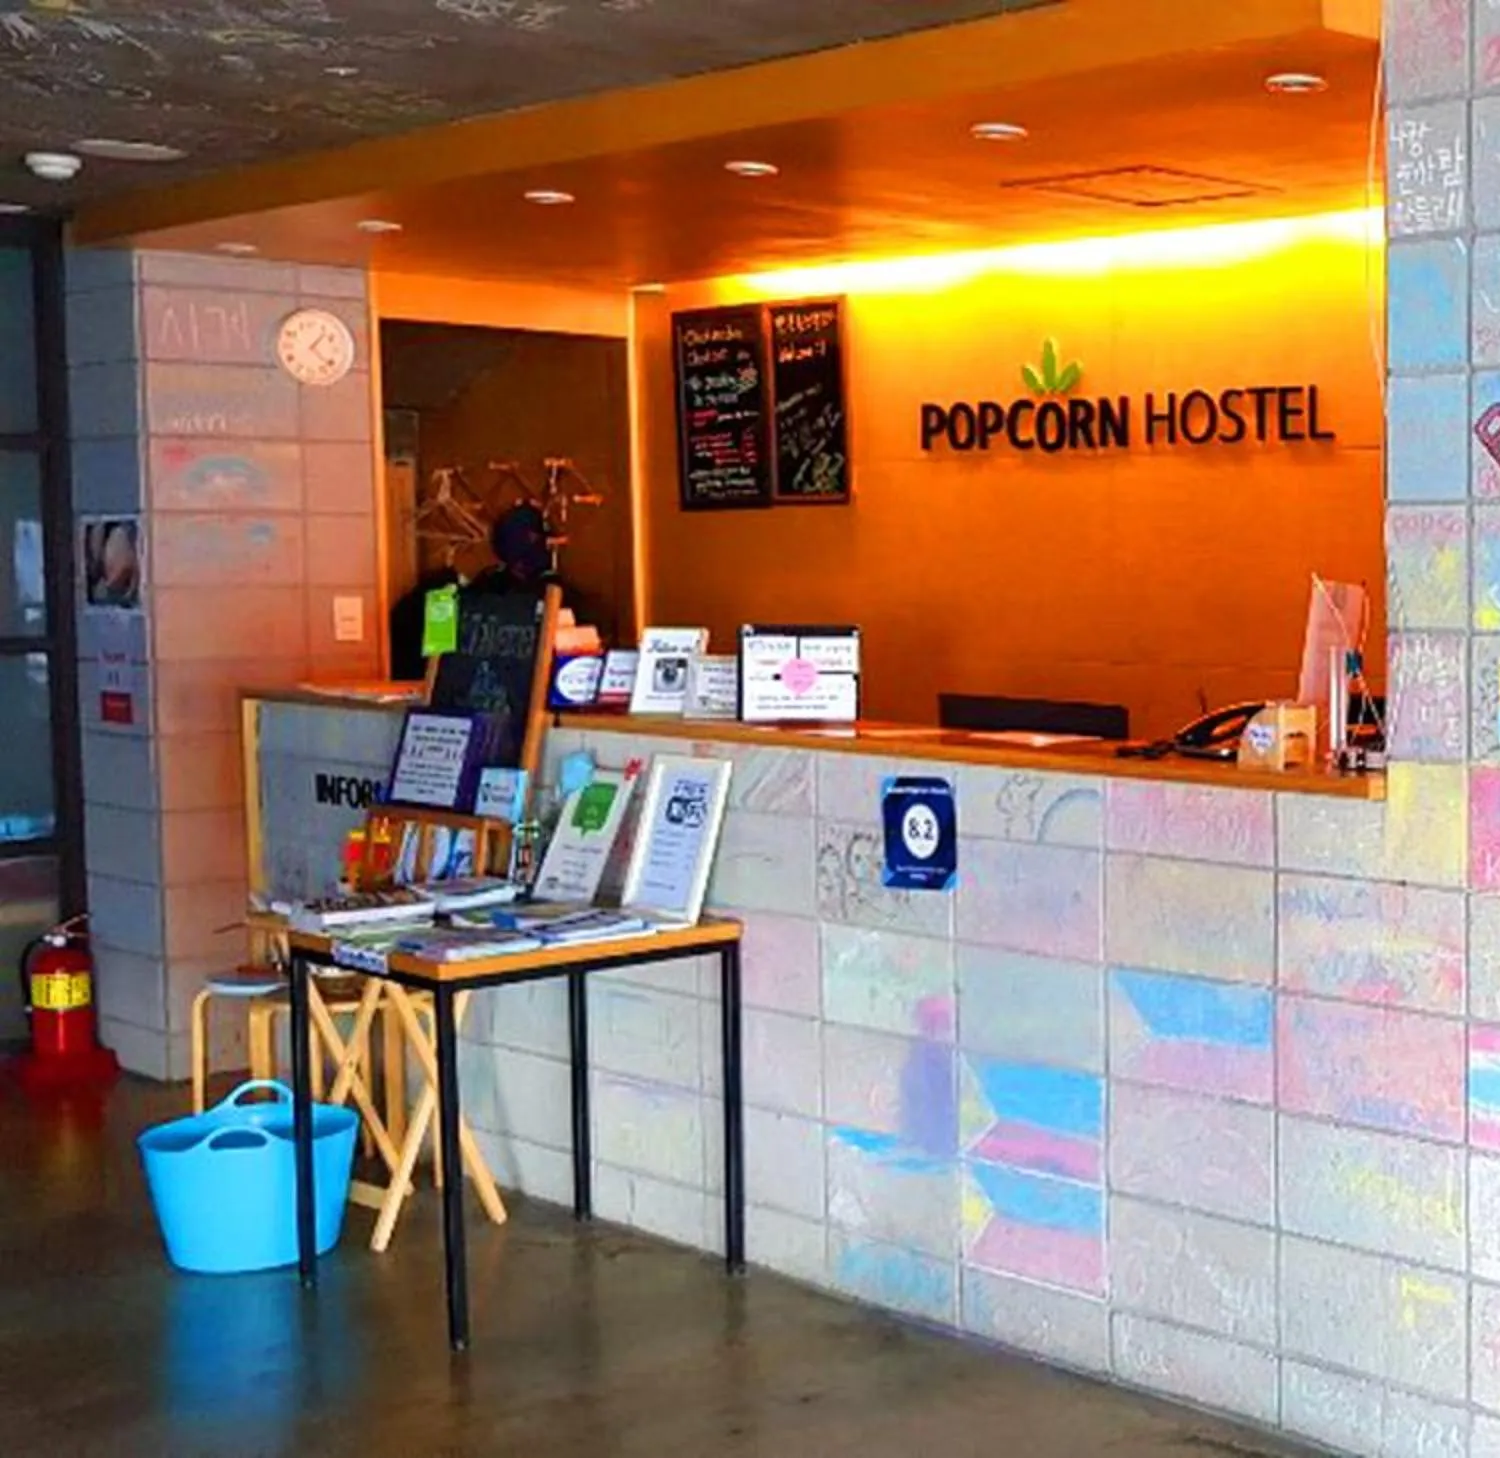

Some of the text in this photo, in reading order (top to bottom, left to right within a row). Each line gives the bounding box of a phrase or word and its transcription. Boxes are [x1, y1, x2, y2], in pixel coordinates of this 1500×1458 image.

[921, 384, 1336, 453] POPCORN HOSTEL
[315, 772, 381, 808] INFOR
[908, 817, 934, 841] 8.2
